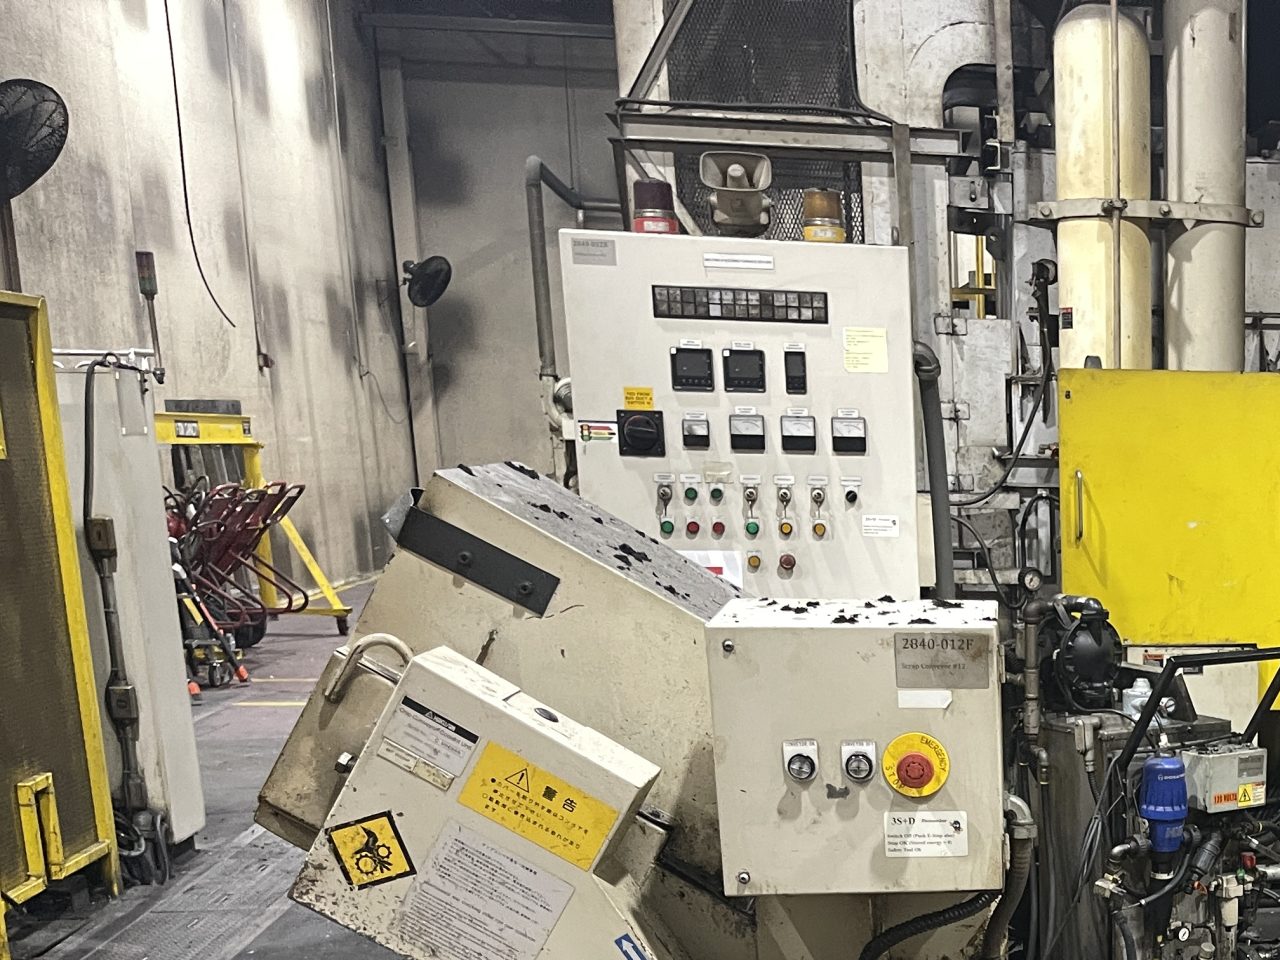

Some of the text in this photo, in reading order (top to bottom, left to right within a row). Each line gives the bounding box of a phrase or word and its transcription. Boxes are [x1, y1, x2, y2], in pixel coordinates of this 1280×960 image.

[902, 638, 974, 650] 2840-012F
[919, 736, 948, 772] EMERGENCY
[885, 764, 906, 790] STOP
[542, 785, 578, 814] 警告
[891, 817, 916, 826] 3S+D
